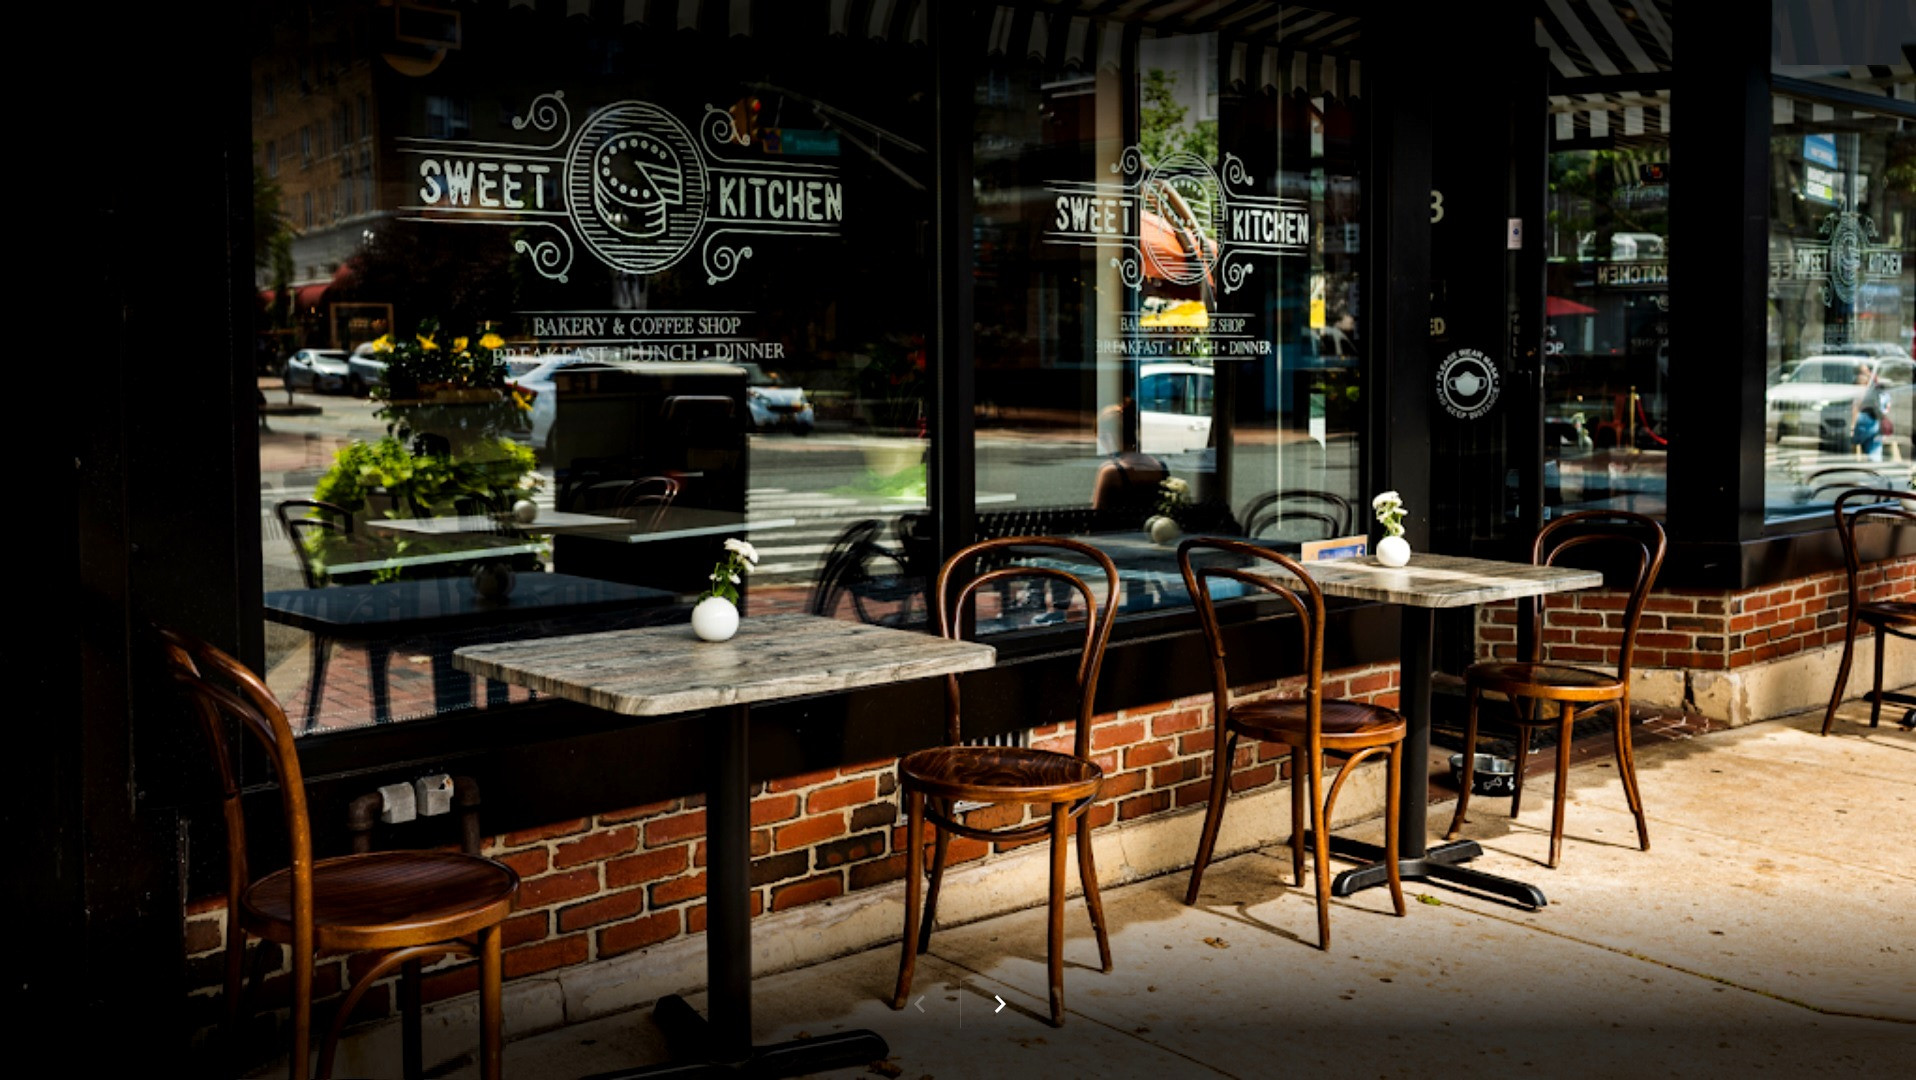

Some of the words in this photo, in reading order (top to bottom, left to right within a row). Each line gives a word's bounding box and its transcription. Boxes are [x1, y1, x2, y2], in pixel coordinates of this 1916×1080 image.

[420, 158, 550, 208] SWEET
[719, 176, 843, 221] KITCHEN
[1056, 196, 1133, 233] SWEET
[1232, 209, 1309, 244] KITCHEN
[533, 317, 607, 337] BAKERY
[612, 317, 625, 336] &
[630, 317, 694, 335] COFFEE
[698, 317, 741, 335] SHOP
[1218, 318, 1246, 332] SHOP
[628, 343, 697, 362] LUNCH
[715, 343, 785, 360] DINNER
[1097, 340, 1165, 355] BREAKFAST
[1177, 340, 1219, 355] LUNCH
[1229, 341, 1272, 355] DINNER
